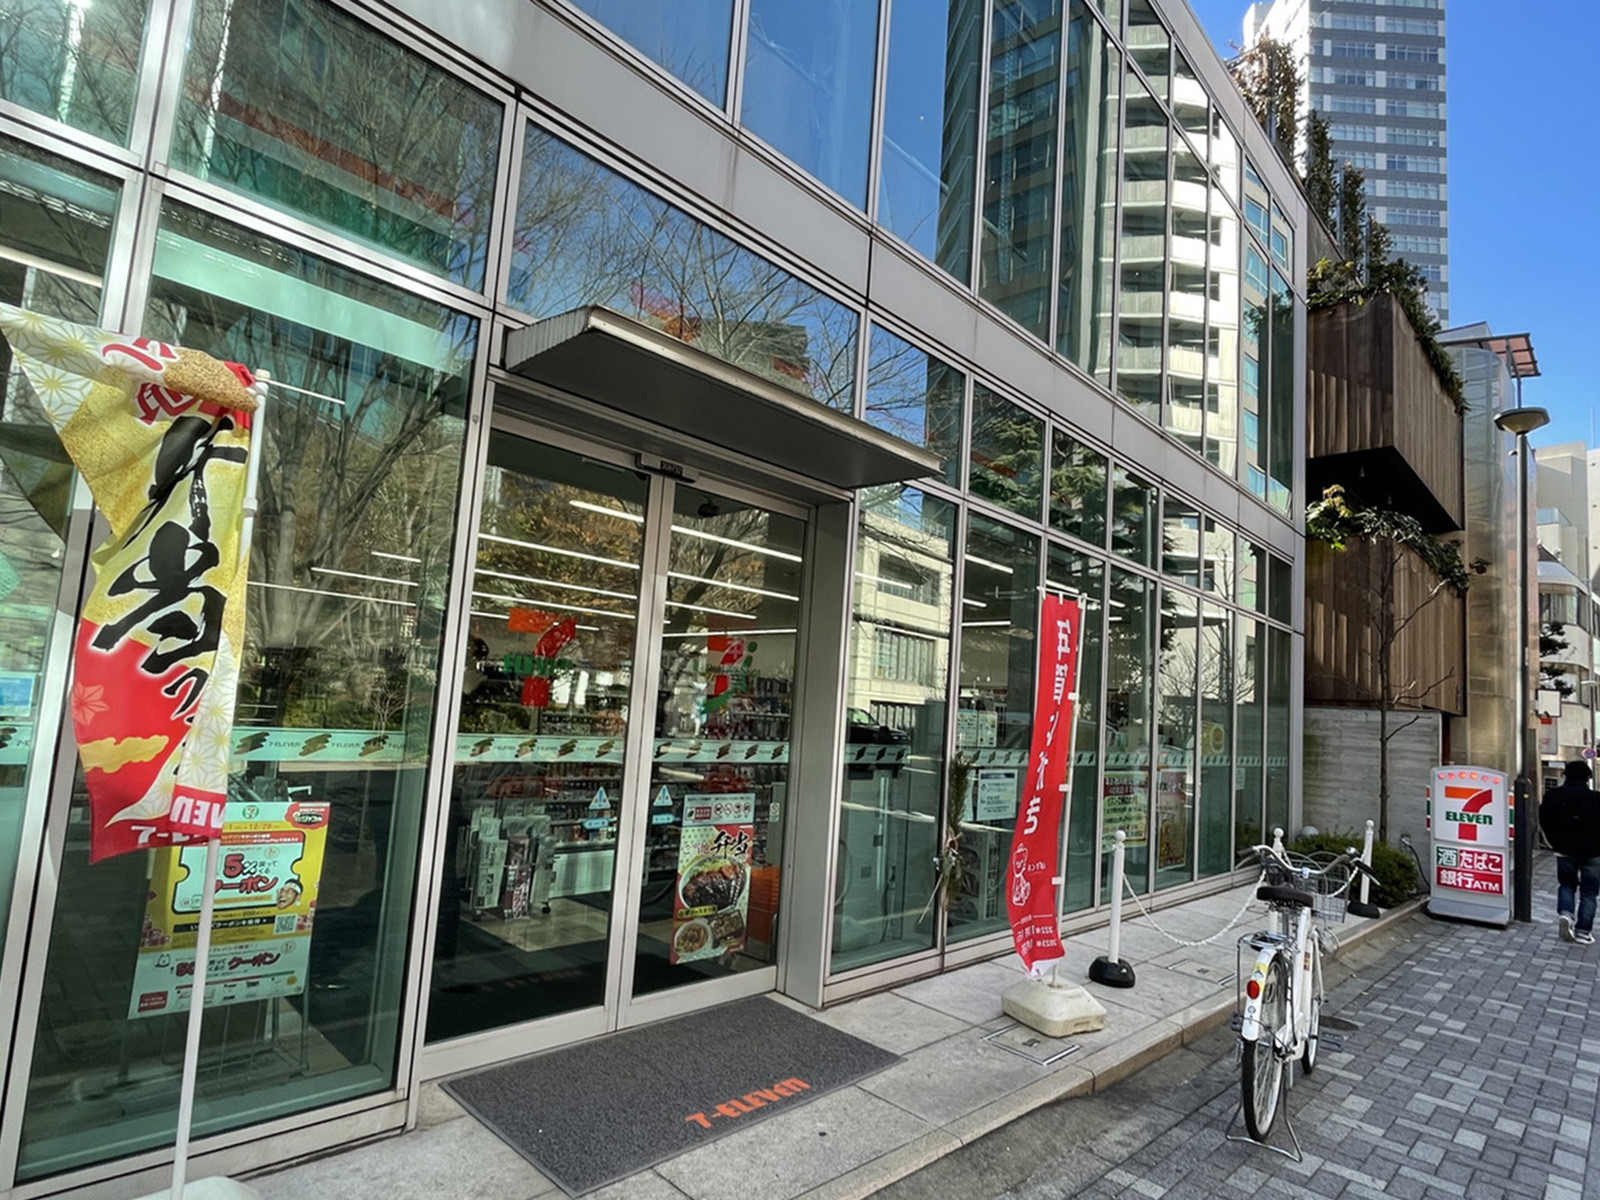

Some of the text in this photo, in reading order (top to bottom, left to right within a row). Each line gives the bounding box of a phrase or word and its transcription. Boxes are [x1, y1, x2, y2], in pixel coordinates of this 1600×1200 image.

[1444, 786, 1493, 841] 7
[223, 853, 258, 878] 5%
[1438, 848, 1457, 867] 酒
[1460, 851, 1502, 872] たばこ
[1440, 869, 1500, 892] 銀行ATM
